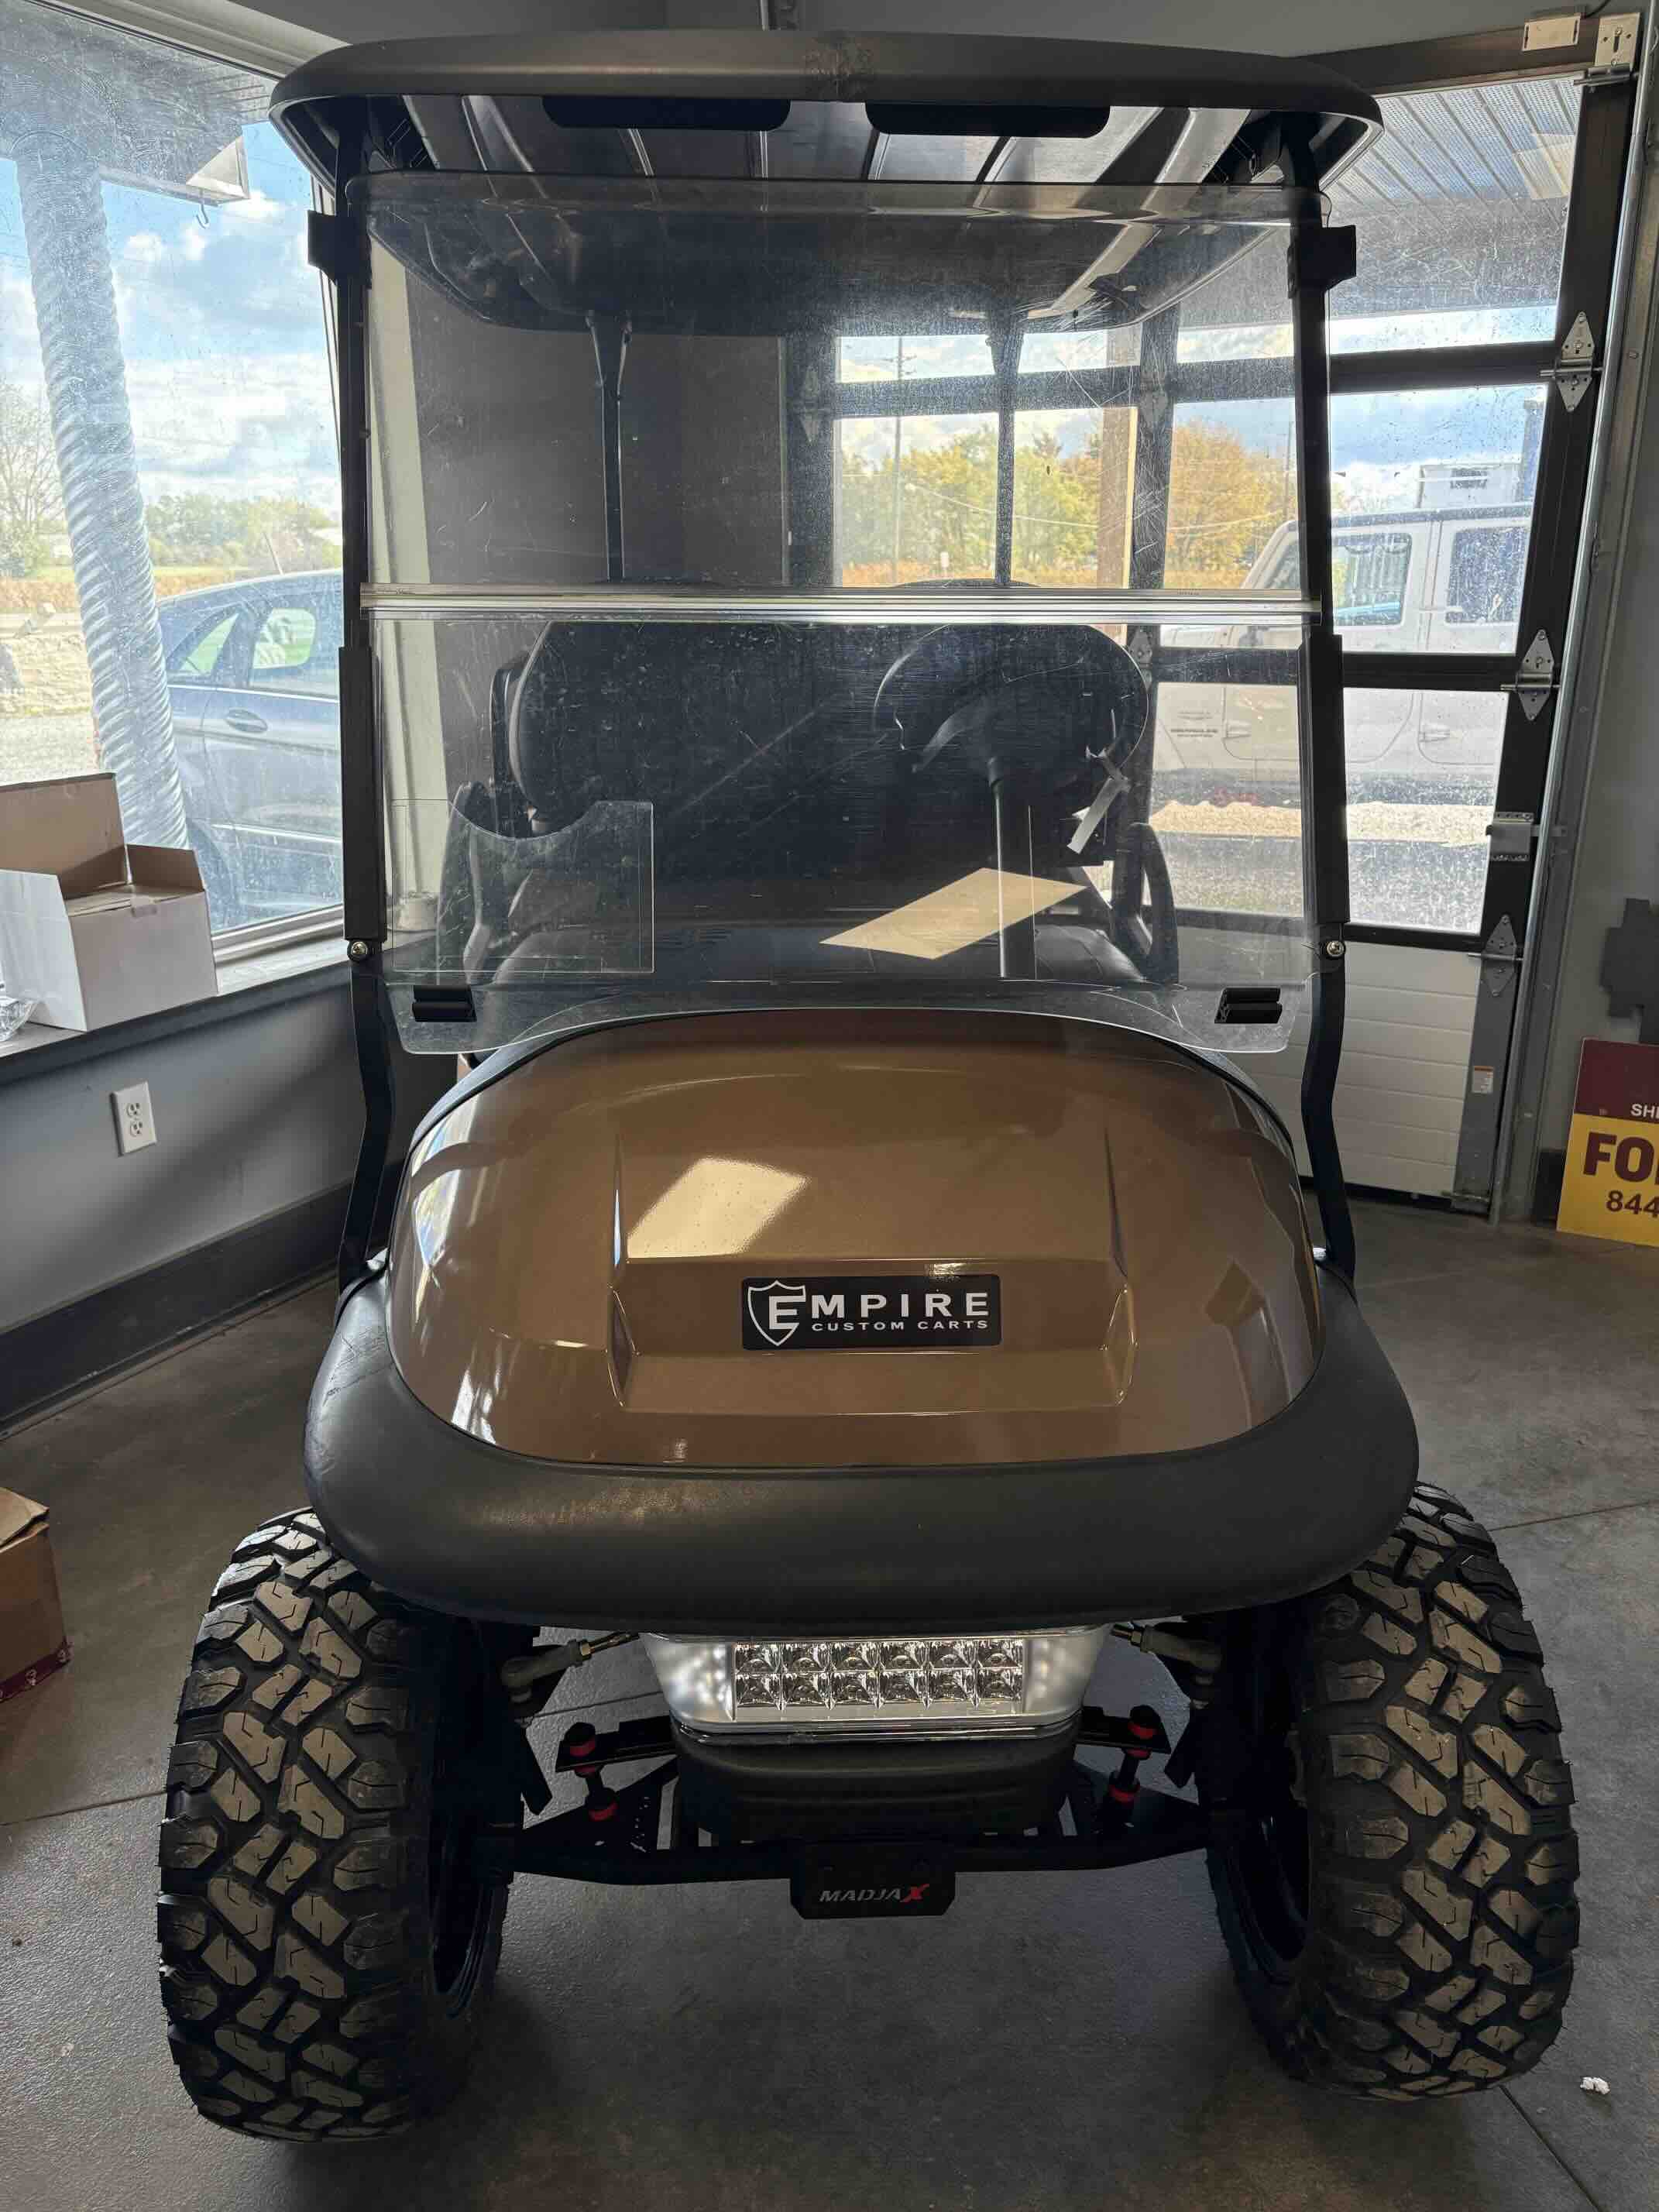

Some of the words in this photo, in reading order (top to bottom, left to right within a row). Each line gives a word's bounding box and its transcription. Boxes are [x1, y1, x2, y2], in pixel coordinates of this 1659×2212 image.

[1583, 1132, 1659, 1185] FO
[769, 1293, 988, 1330] EMPIRE
[812, 1321, 904, 1331] CUSTOM
[918, 1320, 988, 1330] CARTS
[819, 1884, 929, 1903] MADJAX
